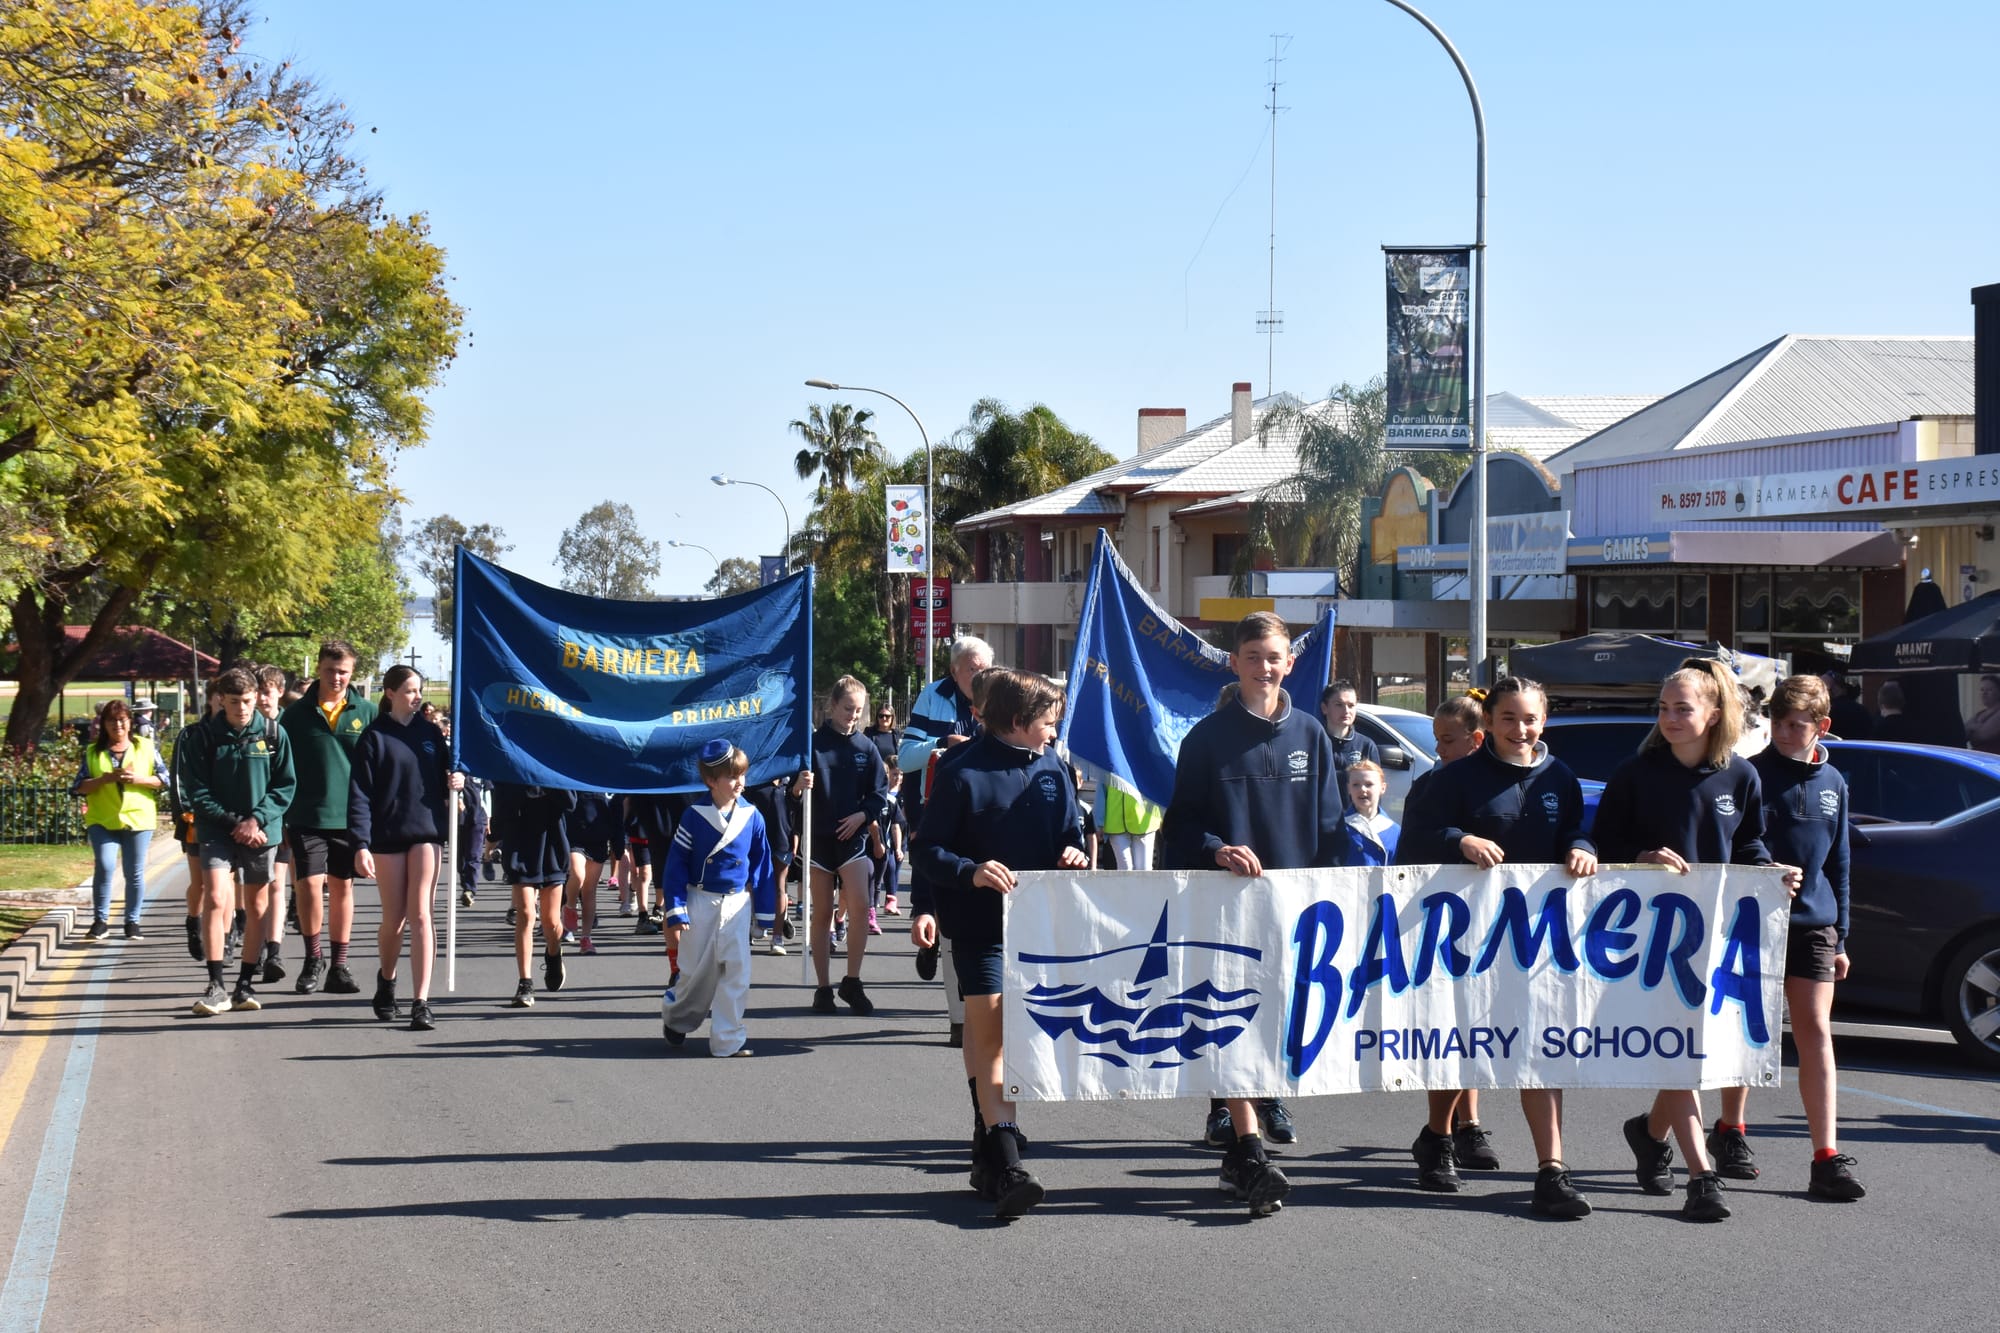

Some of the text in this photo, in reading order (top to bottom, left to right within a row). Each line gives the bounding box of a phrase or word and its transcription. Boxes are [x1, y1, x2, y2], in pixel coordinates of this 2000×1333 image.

[1441, 292, 1466, 301] 2017
[1404, 306, 1419, 314] Tidy
[1392, 414, 1465, 424] Overall Winner
[1388, 428, 1468, 438] BARMERA SA
[1661, 469, 1999, 509] Ph. 8597 5178 BARMERA CAFE ESPRES
[1603, 536, 1650, 562] GAMES
[1409, 548, 1436, 568] DVDs
[916, 588, 945, 596] WST
[919, 599, 942, 607] ED
[914, 620, 947, 628] Barera
[1895, 642, 1933, 656] AMANTI
[562, 641, 702, 676] BARMERA
[672, 697, 763, 724] PRIMARY
[1282, 886, 1770, 1081] BARMERA
[1354, 1025, 1708, 1062] PRIMARY SCHOOL
